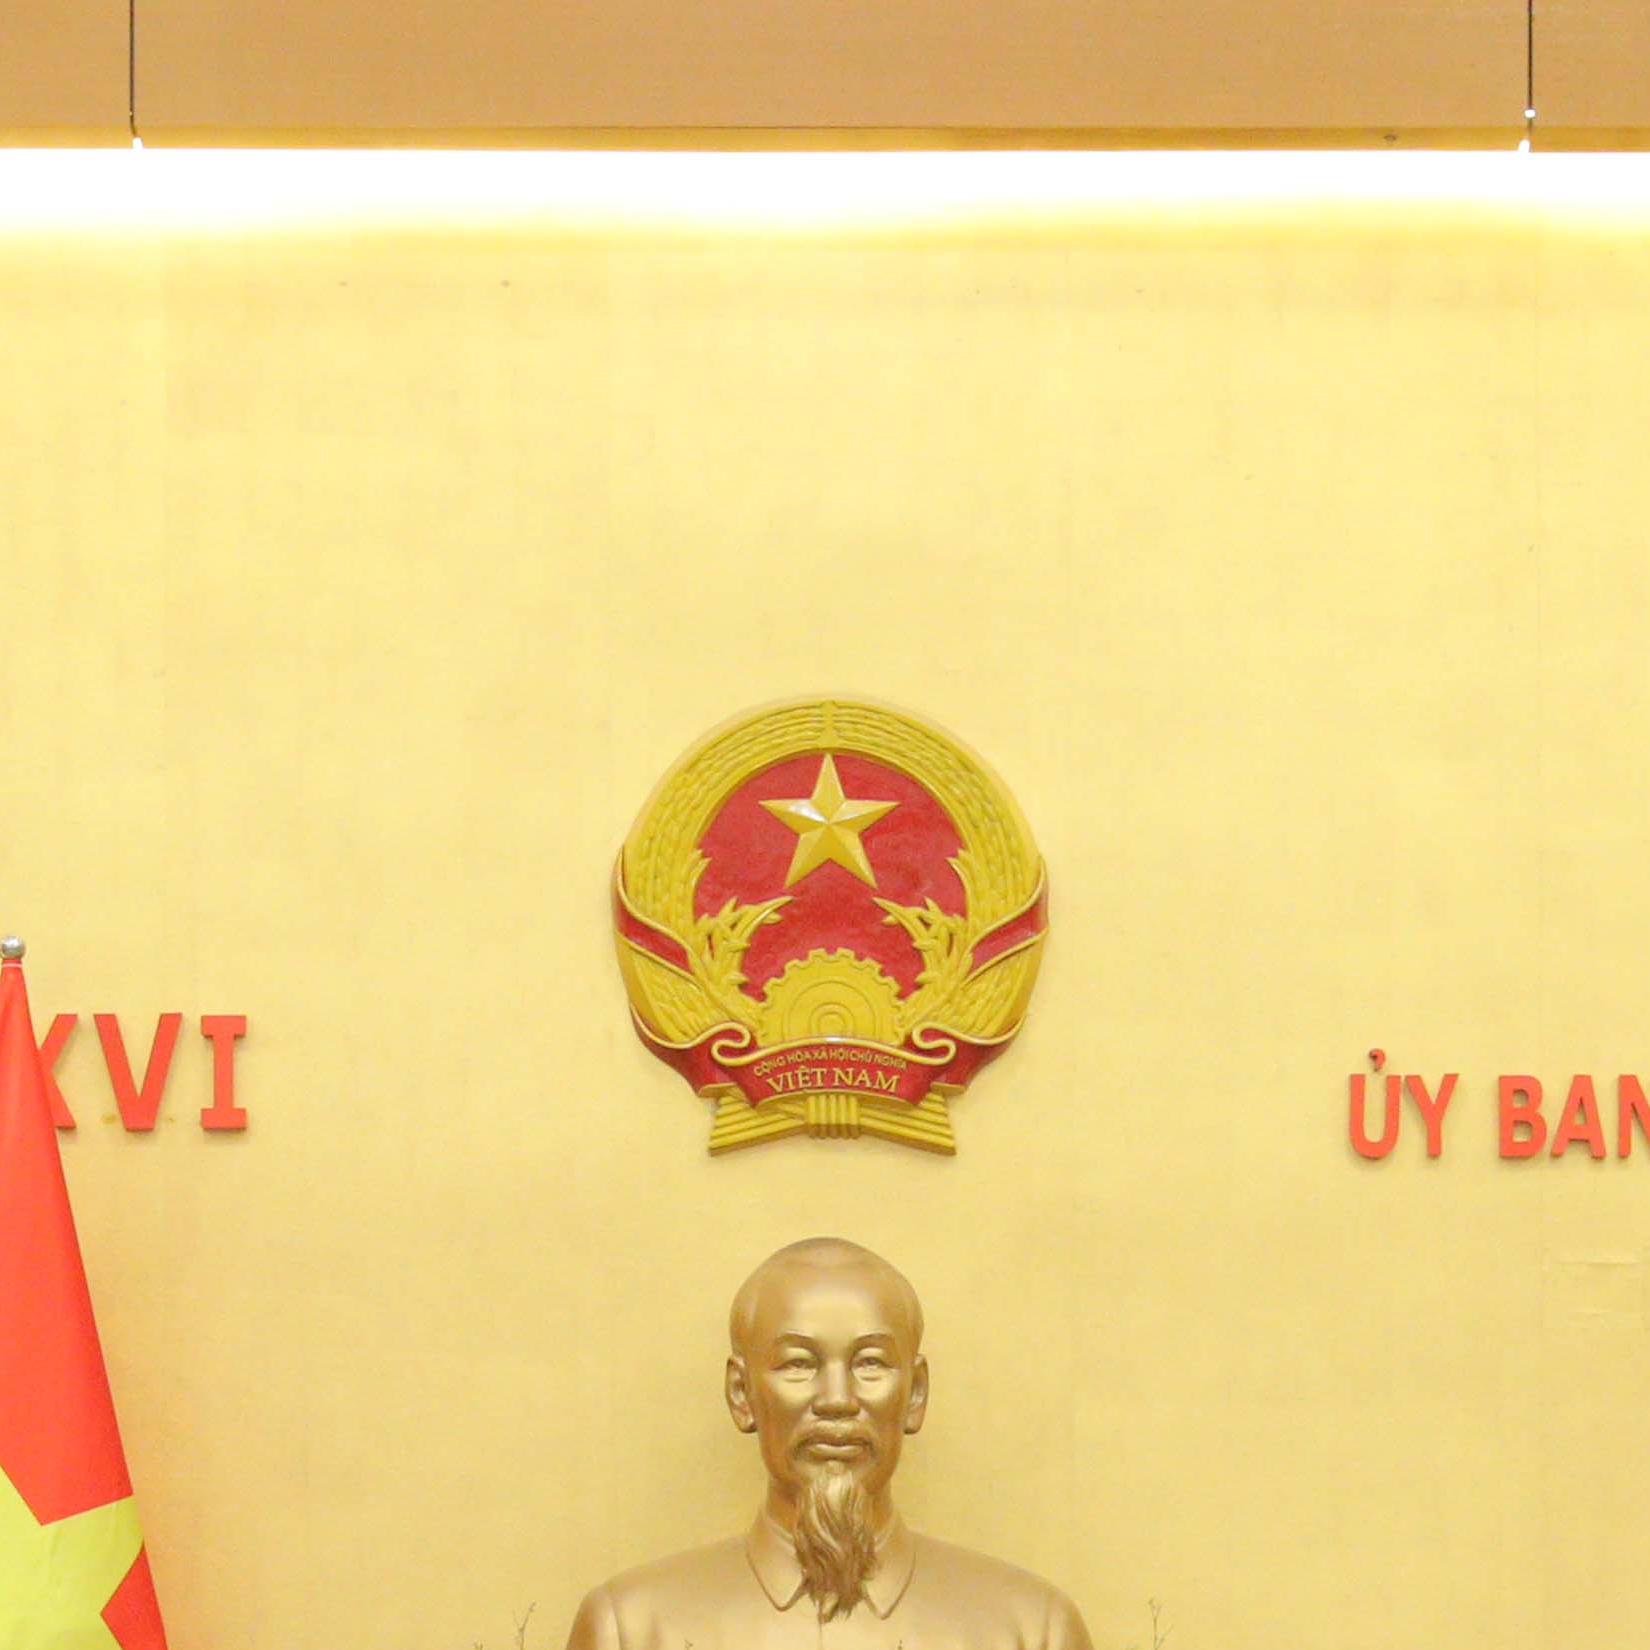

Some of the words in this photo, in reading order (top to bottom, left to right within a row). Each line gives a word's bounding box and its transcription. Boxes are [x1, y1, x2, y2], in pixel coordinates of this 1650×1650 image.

[766, 1065, 827, 1093] VIỆT
[831, 1067, 900, 1092] NAM
[1349, 1048, 1458, 1160] ỦY
